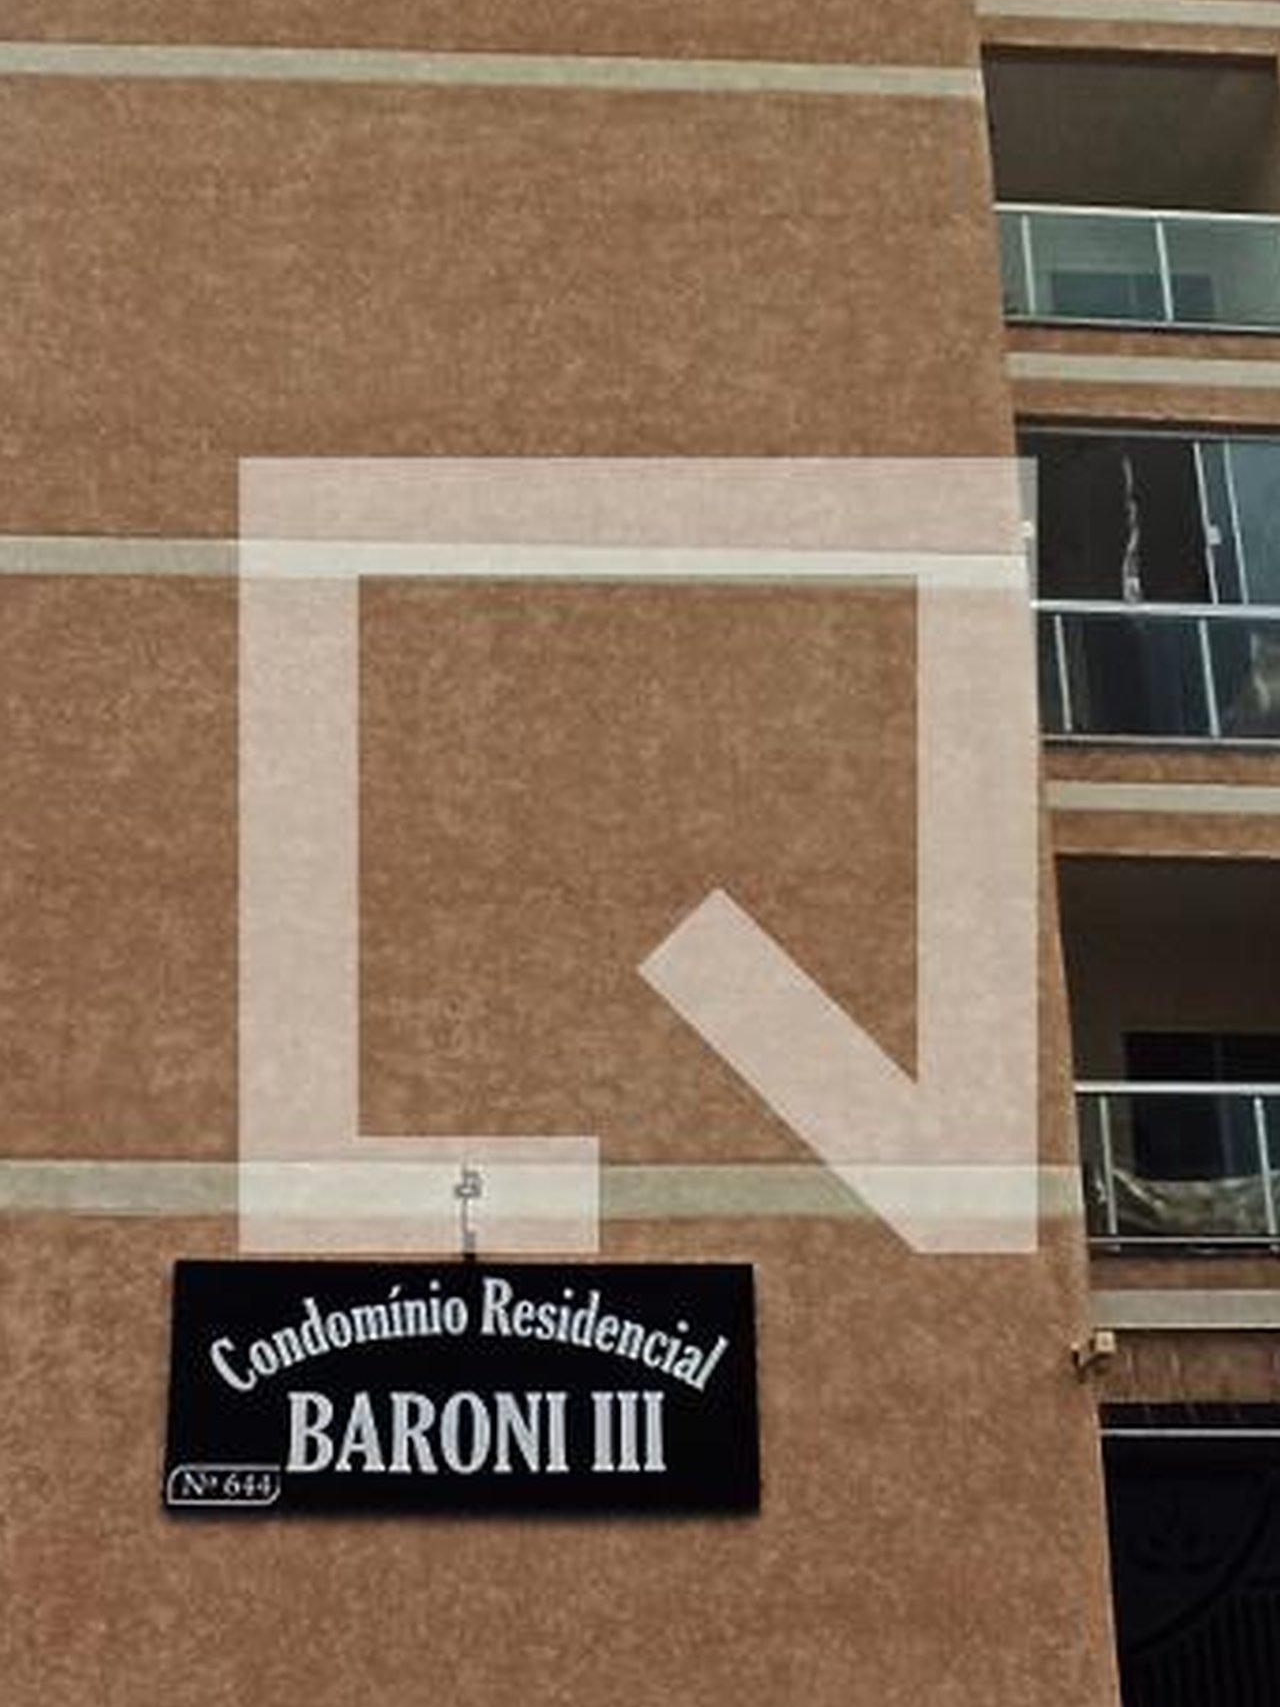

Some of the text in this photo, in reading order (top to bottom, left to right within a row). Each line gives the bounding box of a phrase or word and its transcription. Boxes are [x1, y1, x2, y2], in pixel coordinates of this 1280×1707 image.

[209, 1277, 728, 1392] Condomínio Residencial
[286, 1390, 667, 1475] BARONI III
[223, 1472, 272, 1497] 644
